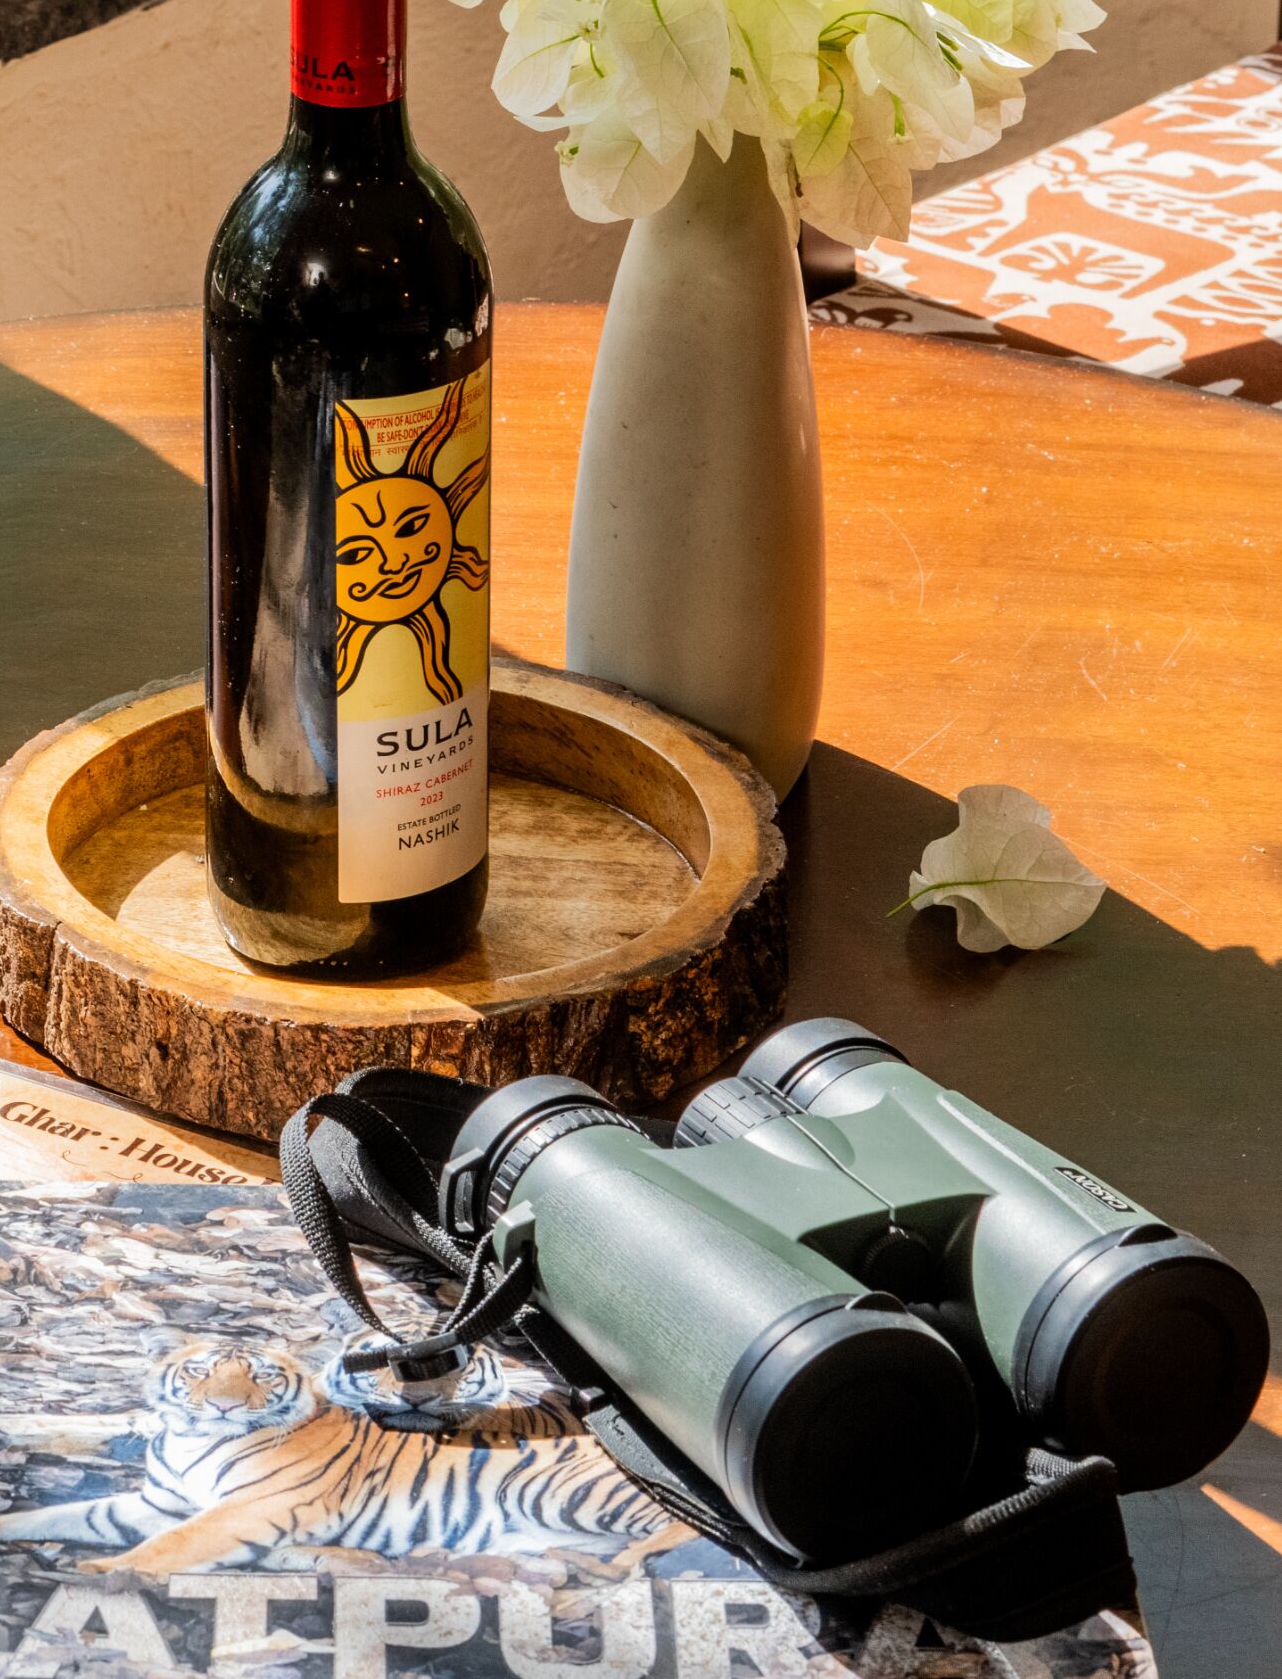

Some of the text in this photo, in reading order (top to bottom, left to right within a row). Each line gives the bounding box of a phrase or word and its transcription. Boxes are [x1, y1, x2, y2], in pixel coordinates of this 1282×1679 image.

[377, 432, 385, 443] BE
[376, 707, 473, 757] SULA
[377, 735, 474, 775] VINEYARDS
[376, 759, 474, 799] SHIRAZ CABERNET
[420, 791, 444, 807] 2023
[397, 804, 462, 832] ESTATE BOTTLED
[398, 818, 461, 851] NASHIK
[0, 1101, 102, 1142] Ghar
[118, 1137, 248, 1185] House
